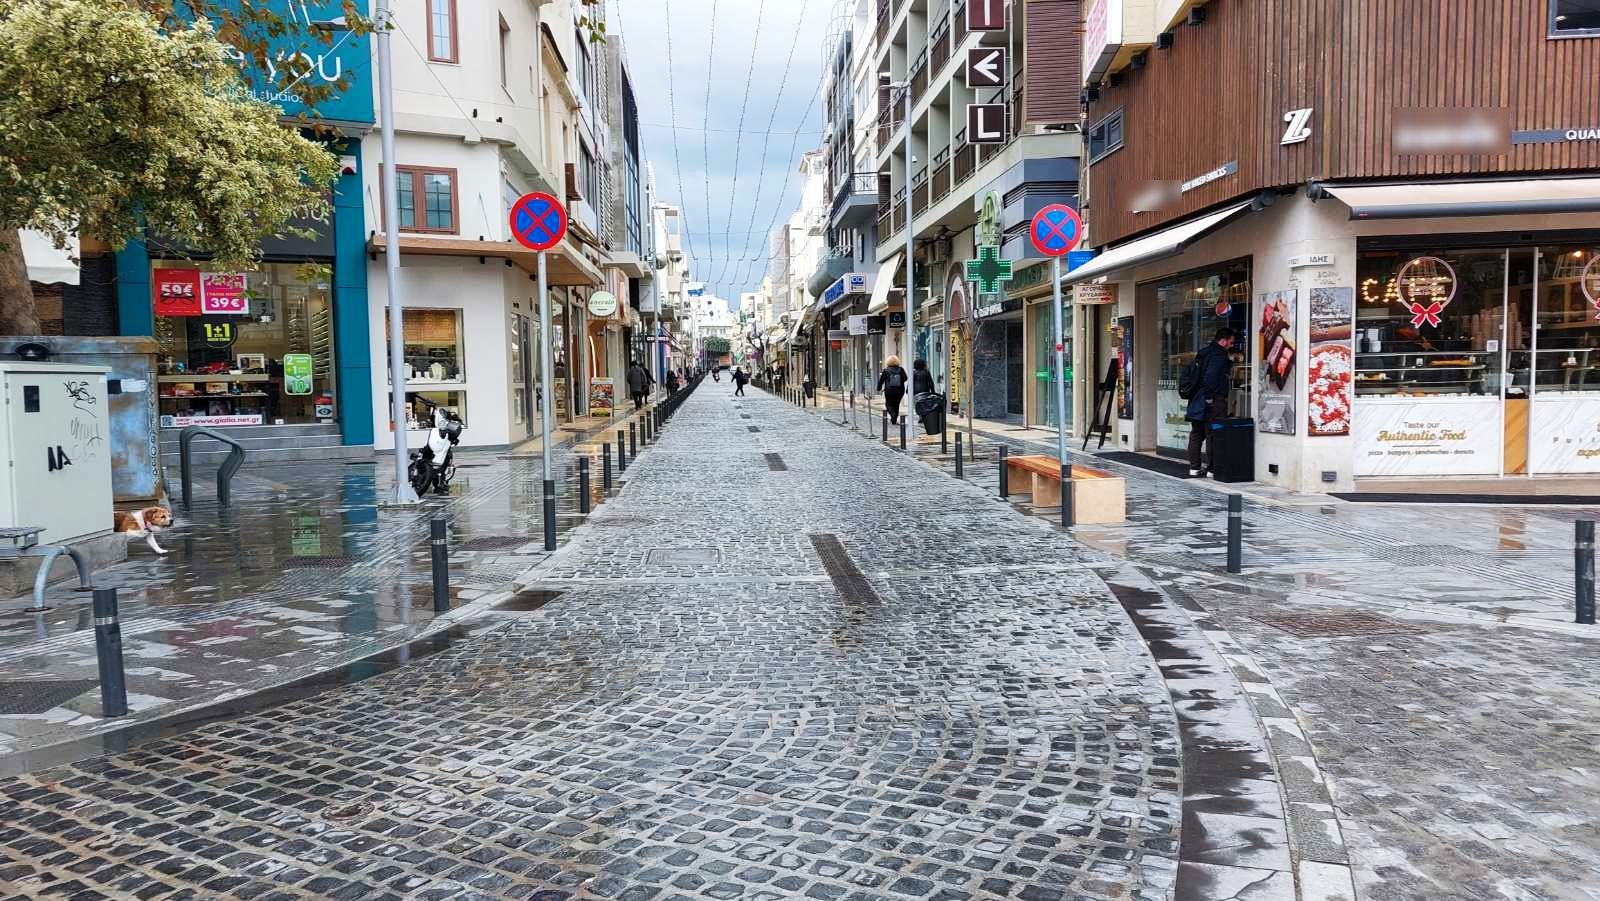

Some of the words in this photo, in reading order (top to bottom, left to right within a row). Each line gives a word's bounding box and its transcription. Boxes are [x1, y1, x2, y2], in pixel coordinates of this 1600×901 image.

[1280, 108, 1313, 145] Z
[1362, 276, 1448, 302] CAFE
[204, 323, 231, 339] 1+1
[1376, 430, 1436, 441] Authentic
[1439, 429, 1467, 440] Food
